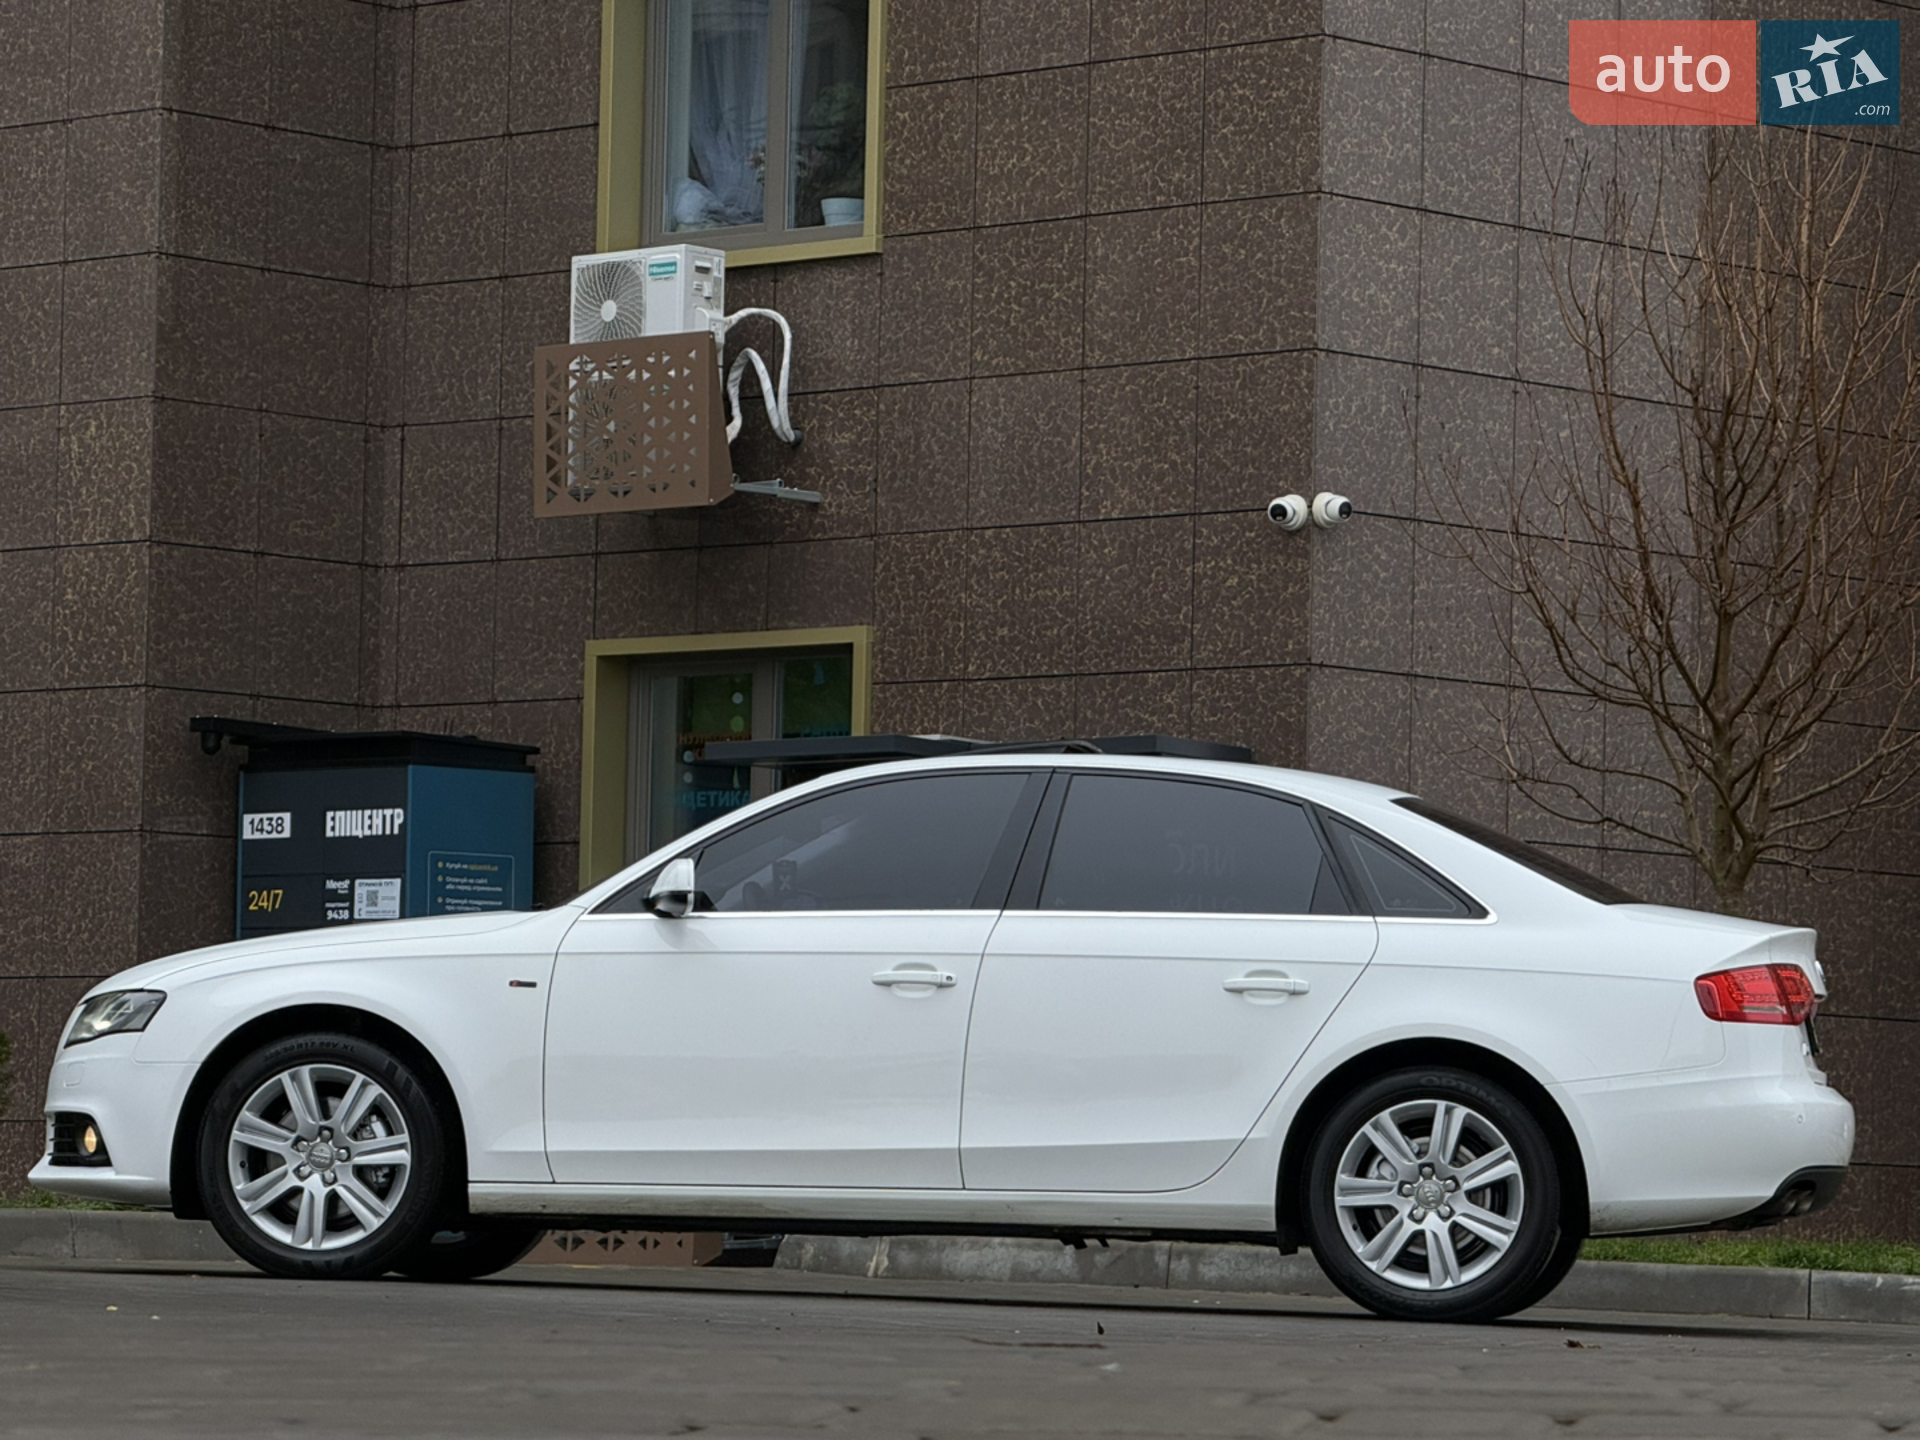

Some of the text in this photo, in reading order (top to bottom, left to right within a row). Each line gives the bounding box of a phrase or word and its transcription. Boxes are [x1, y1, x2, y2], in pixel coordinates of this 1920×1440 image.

[248, 816, 285, 836] 1438
[325, 808, 404, 839] ЕПІЦЕНТР
[248, 889, 284, 912] 24/7
[326, 909, 350, 920] 9438
[1419, 1075, 1512, 1119] OPTIMO
